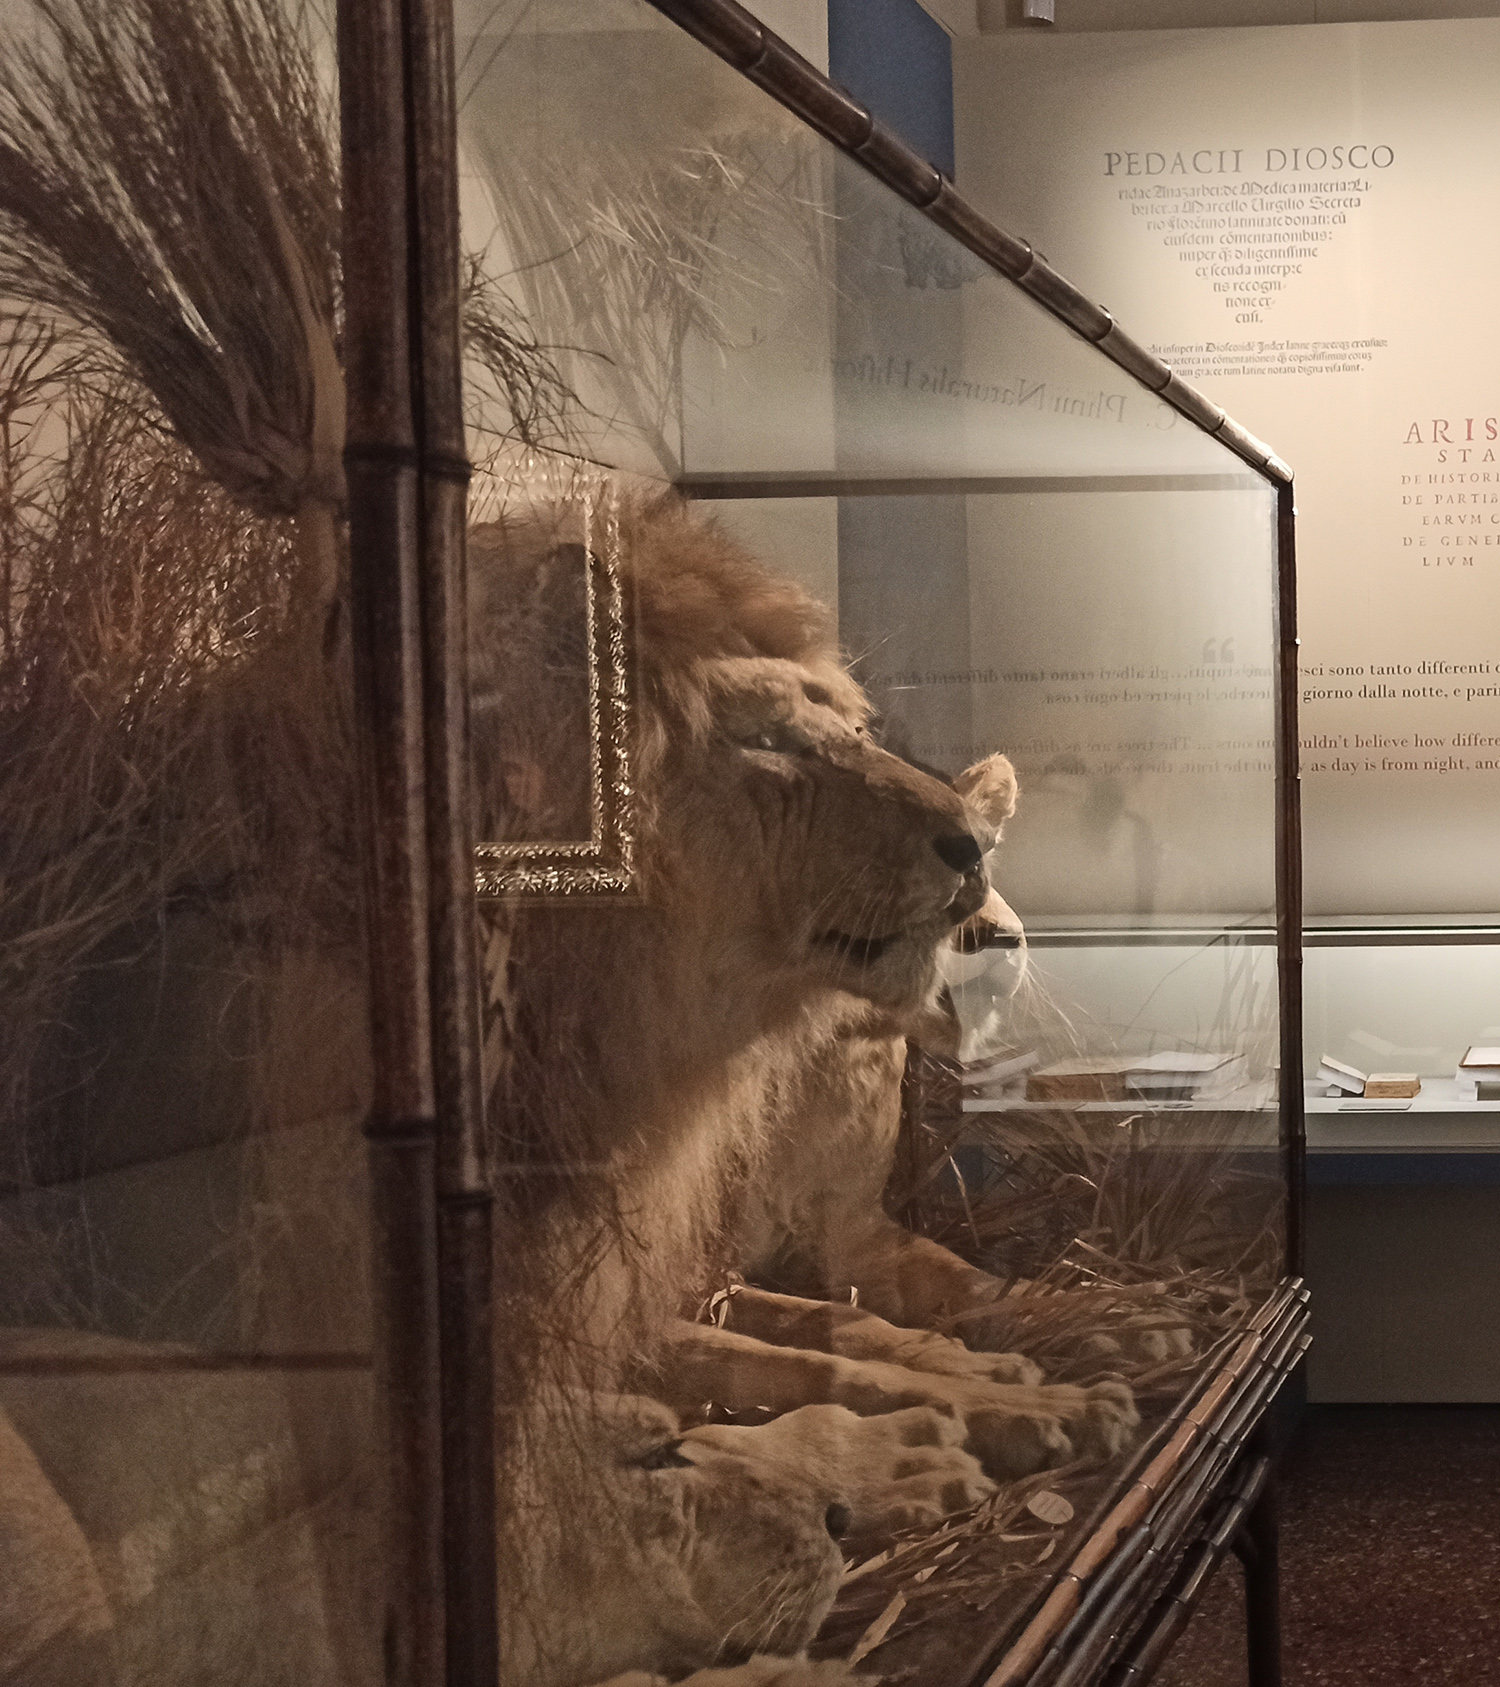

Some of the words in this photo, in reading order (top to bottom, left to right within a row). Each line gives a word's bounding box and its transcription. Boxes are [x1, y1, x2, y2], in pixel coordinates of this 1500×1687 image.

[1102, 148, 1242, 177] PEDACII
[1266, 145, 1394, 171] DIOSCO
[1181, 199, 1247, 213] Marcello
[1402, 475, 1420, 484] DE
[1403, 495, 1422, 505] DE
[1423, 514, 1481, 525] EARVM
[1403, 537, 1426, 546] DE
[1423, 557, 1473, 566] LIVM
[1329, 666, 1363, 675] sono
[1371, 664, 1411, 675] tanto
[1418, 661, 1489, 674] differenti
[1303, 686, 1352, 703] giorno
[1358, 685, 1396, 698] dalla
[1355, 734, 1408, 748] believe
[1415, 734, 1444, 747] how
[1311, 763, 1326, 771] as
[1332, 758, 1357, 775] day
[1365, 758, 1376, 770] is
[1382, 758, 1418, 770] from
[1424, 756, 1469, 774] night,
